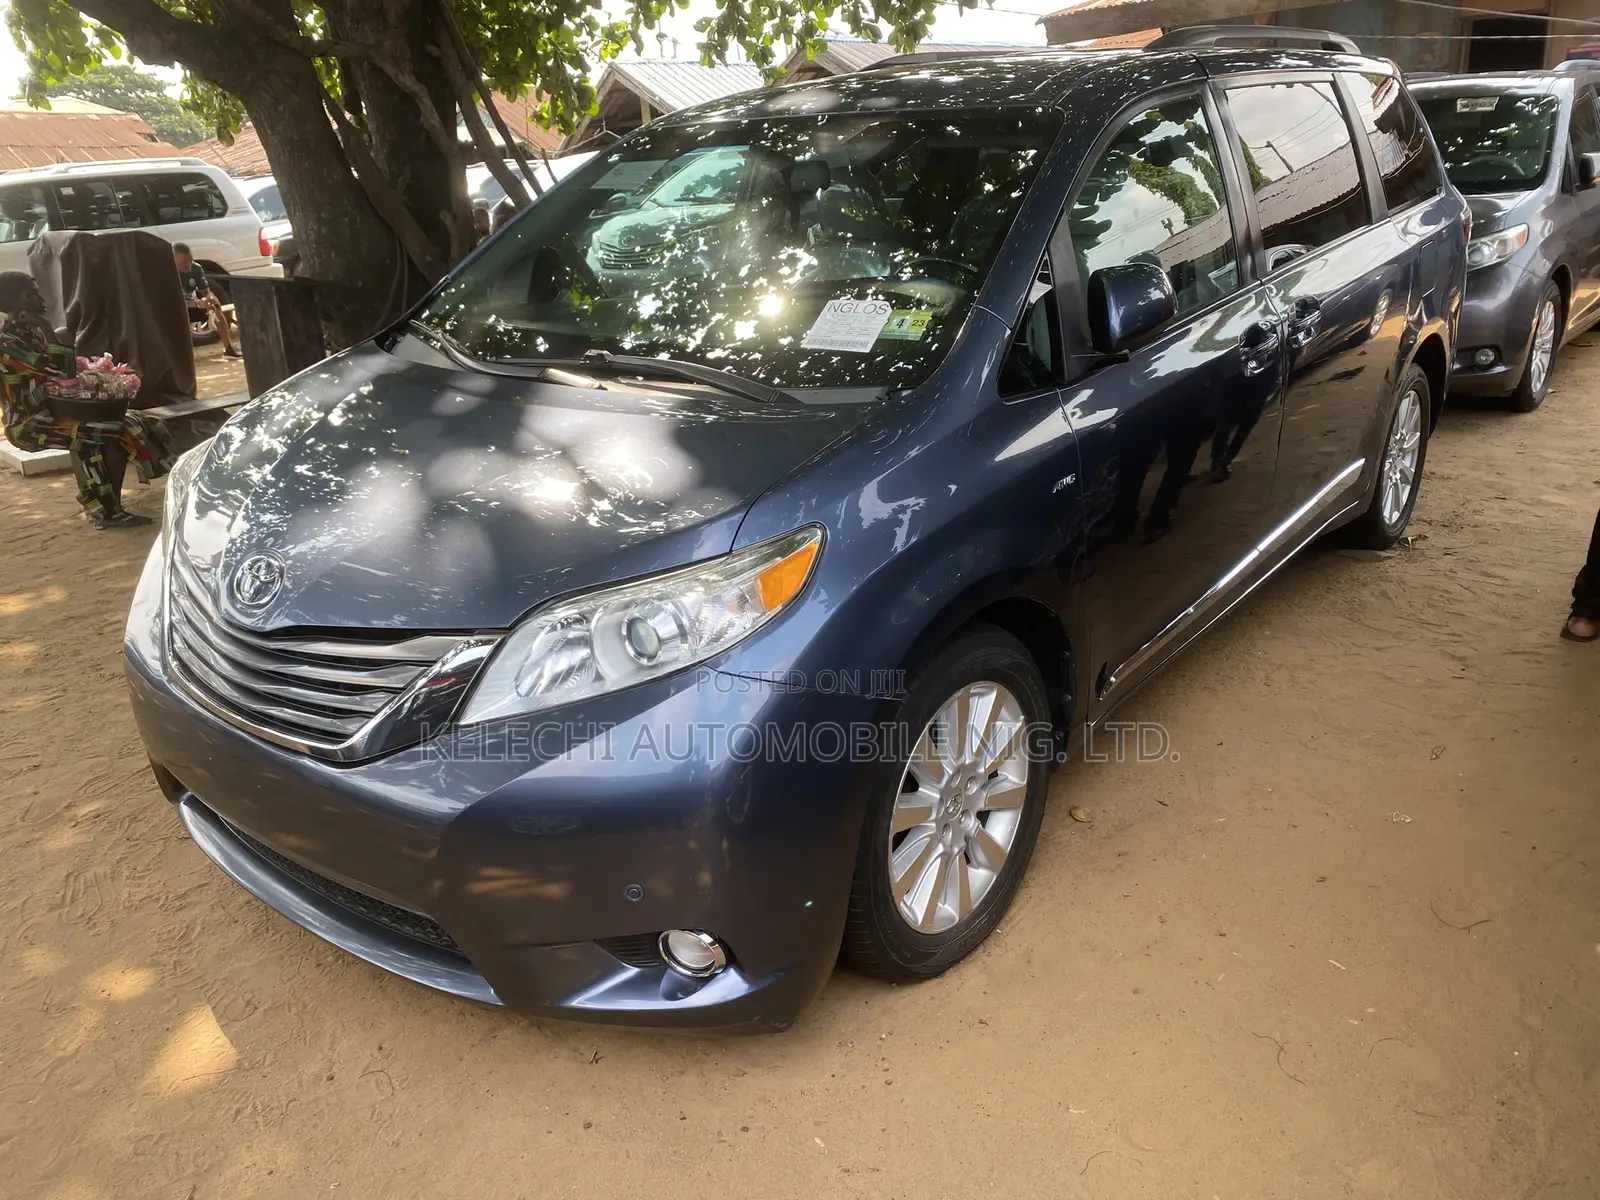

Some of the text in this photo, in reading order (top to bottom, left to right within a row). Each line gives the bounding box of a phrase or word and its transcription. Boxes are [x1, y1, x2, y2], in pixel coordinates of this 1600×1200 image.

[826, 302, 889, 315] NGLOS
[896, 318, 926, 329] 4 23
